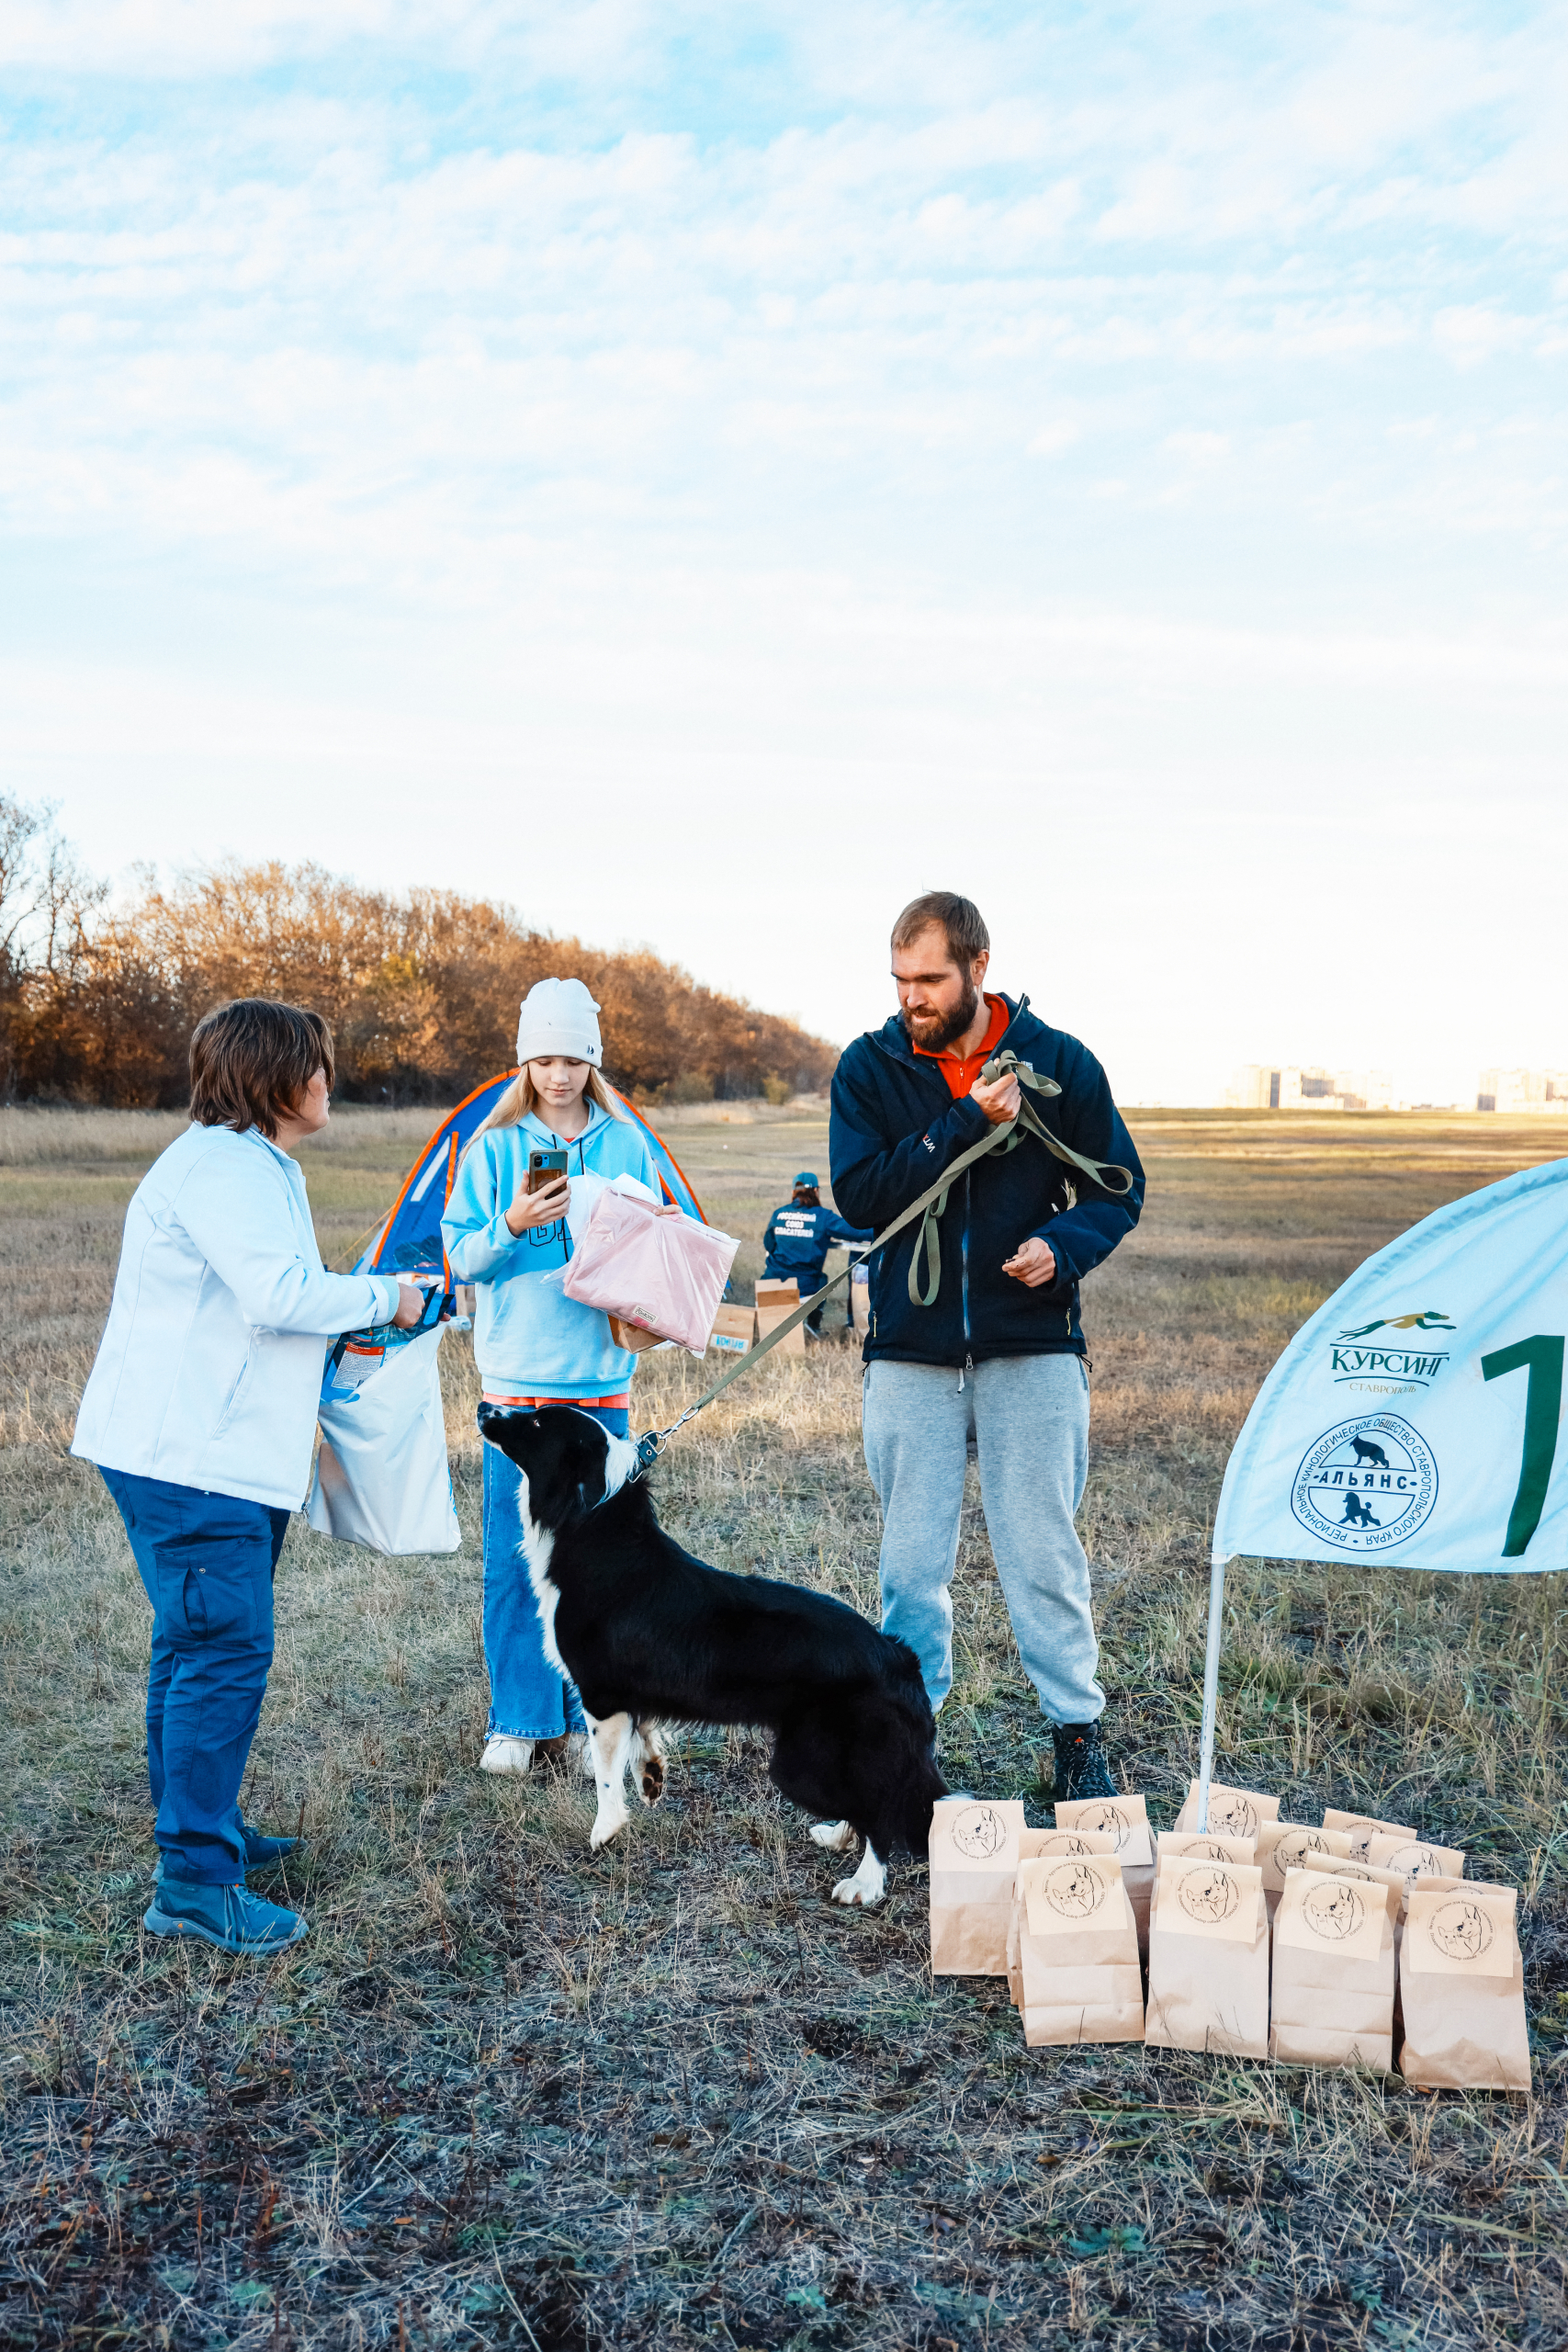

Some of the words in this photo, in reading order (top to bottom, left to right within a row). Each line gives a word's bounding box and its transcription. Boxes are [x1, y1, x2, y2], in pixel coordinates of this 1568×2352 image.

[785, 1219, 804, 1228] СОЮЗ
[1331, 1349, 1450, 1376] КУРСИНГ
[1348, 1382, 1416, 1395] СТАВРОПОЛЬ
[1373, 1418, 1416, 1446] ОБЩЕСТВО
[1481, 1334, 1565, 1557] 1
[1302, 1419, 1372, 1481] КИНОЛОГИЧЕСКОЕ
[1319, 1471, 1407, 1489] АЛЬЯНС
[1393, 1445, 1431, 1536] СТАВРОПОЛЬСКОГО
[1297, 1483, 1348, 1542] РЕГИОНАЛЬНОЕ
[1366, 1530, 1393, 1545] КРАЯ
